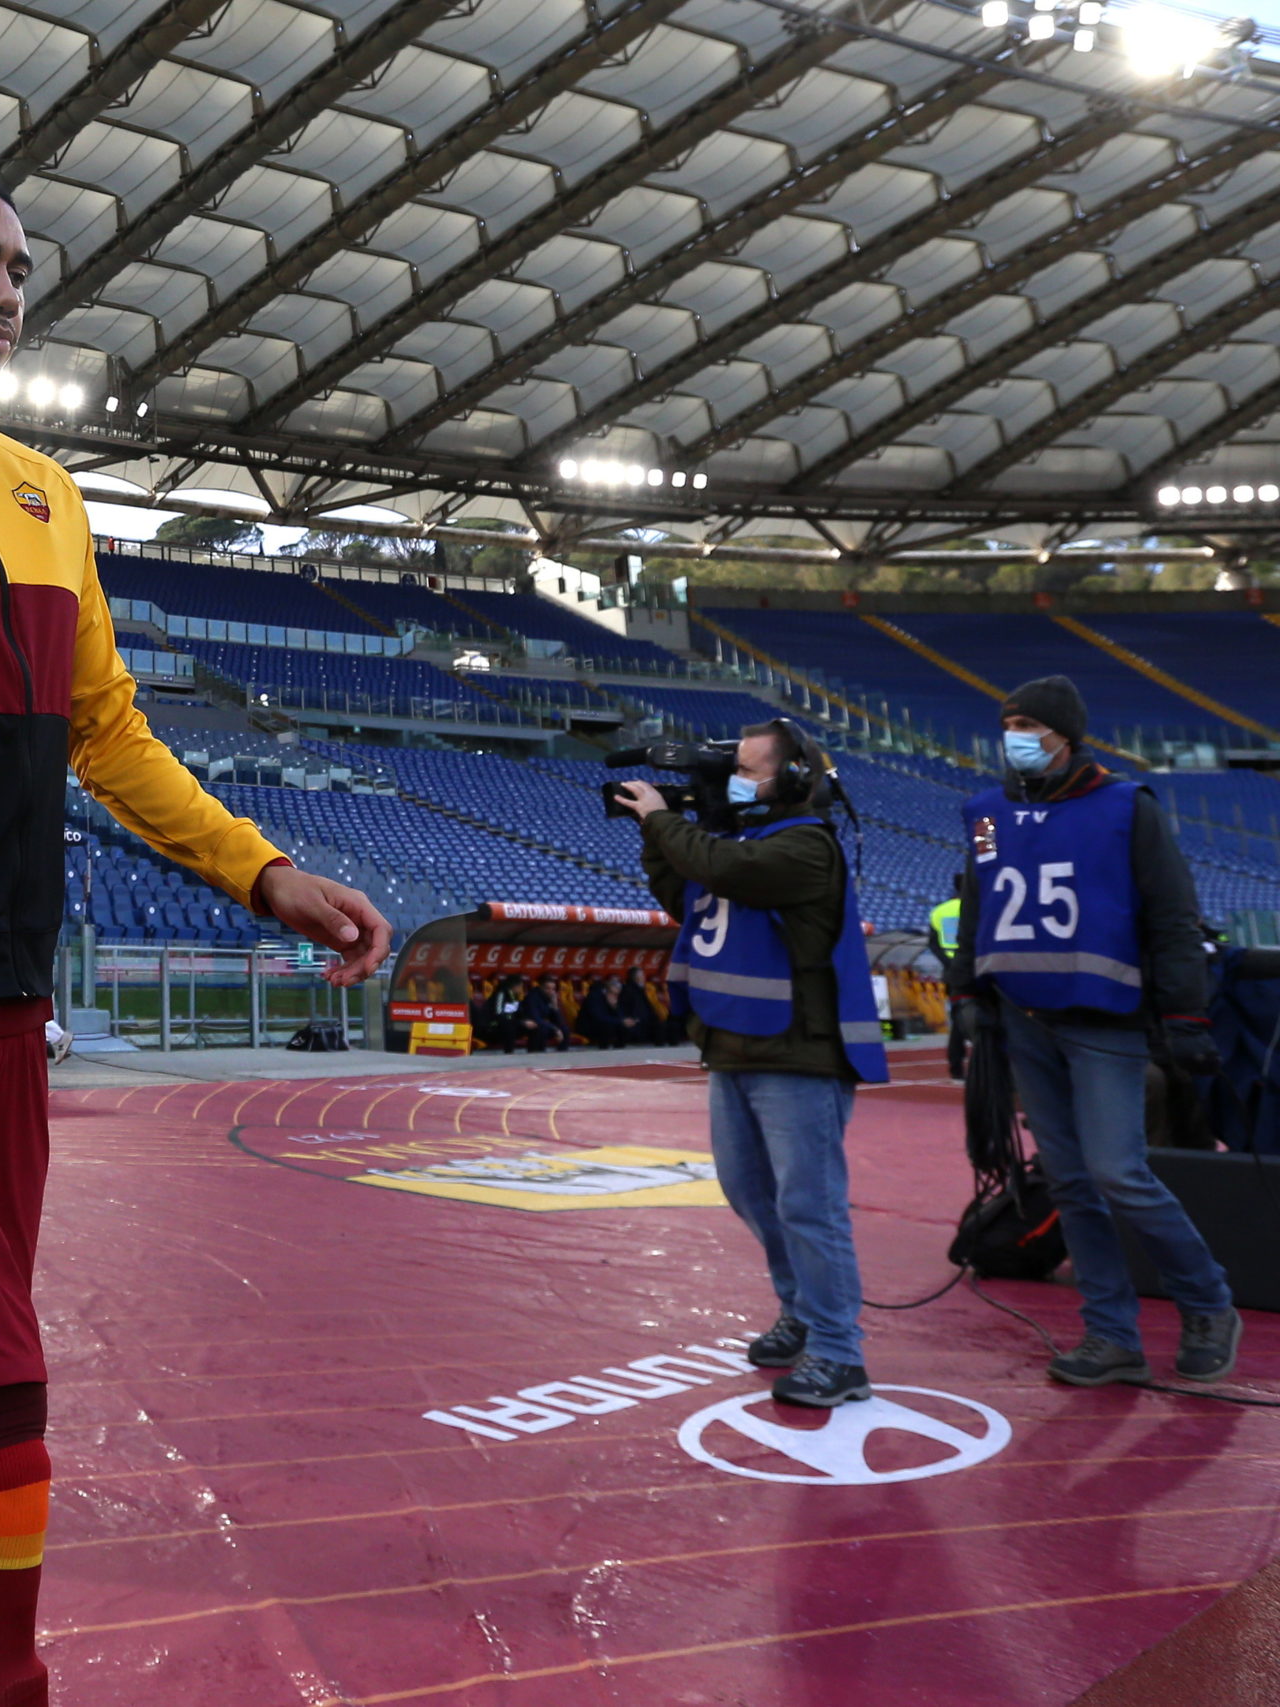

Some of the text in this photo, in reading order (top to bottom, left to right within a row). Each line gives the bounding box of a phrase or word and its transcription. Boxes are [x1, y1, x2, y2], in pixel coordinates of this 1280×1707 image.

[1014, 810, 1049, 825] TV
[992, 861, 1080, 942] 25
[502, 902, 568, 921] GATORADE
[592, 908, 652, 925] GATORADE
